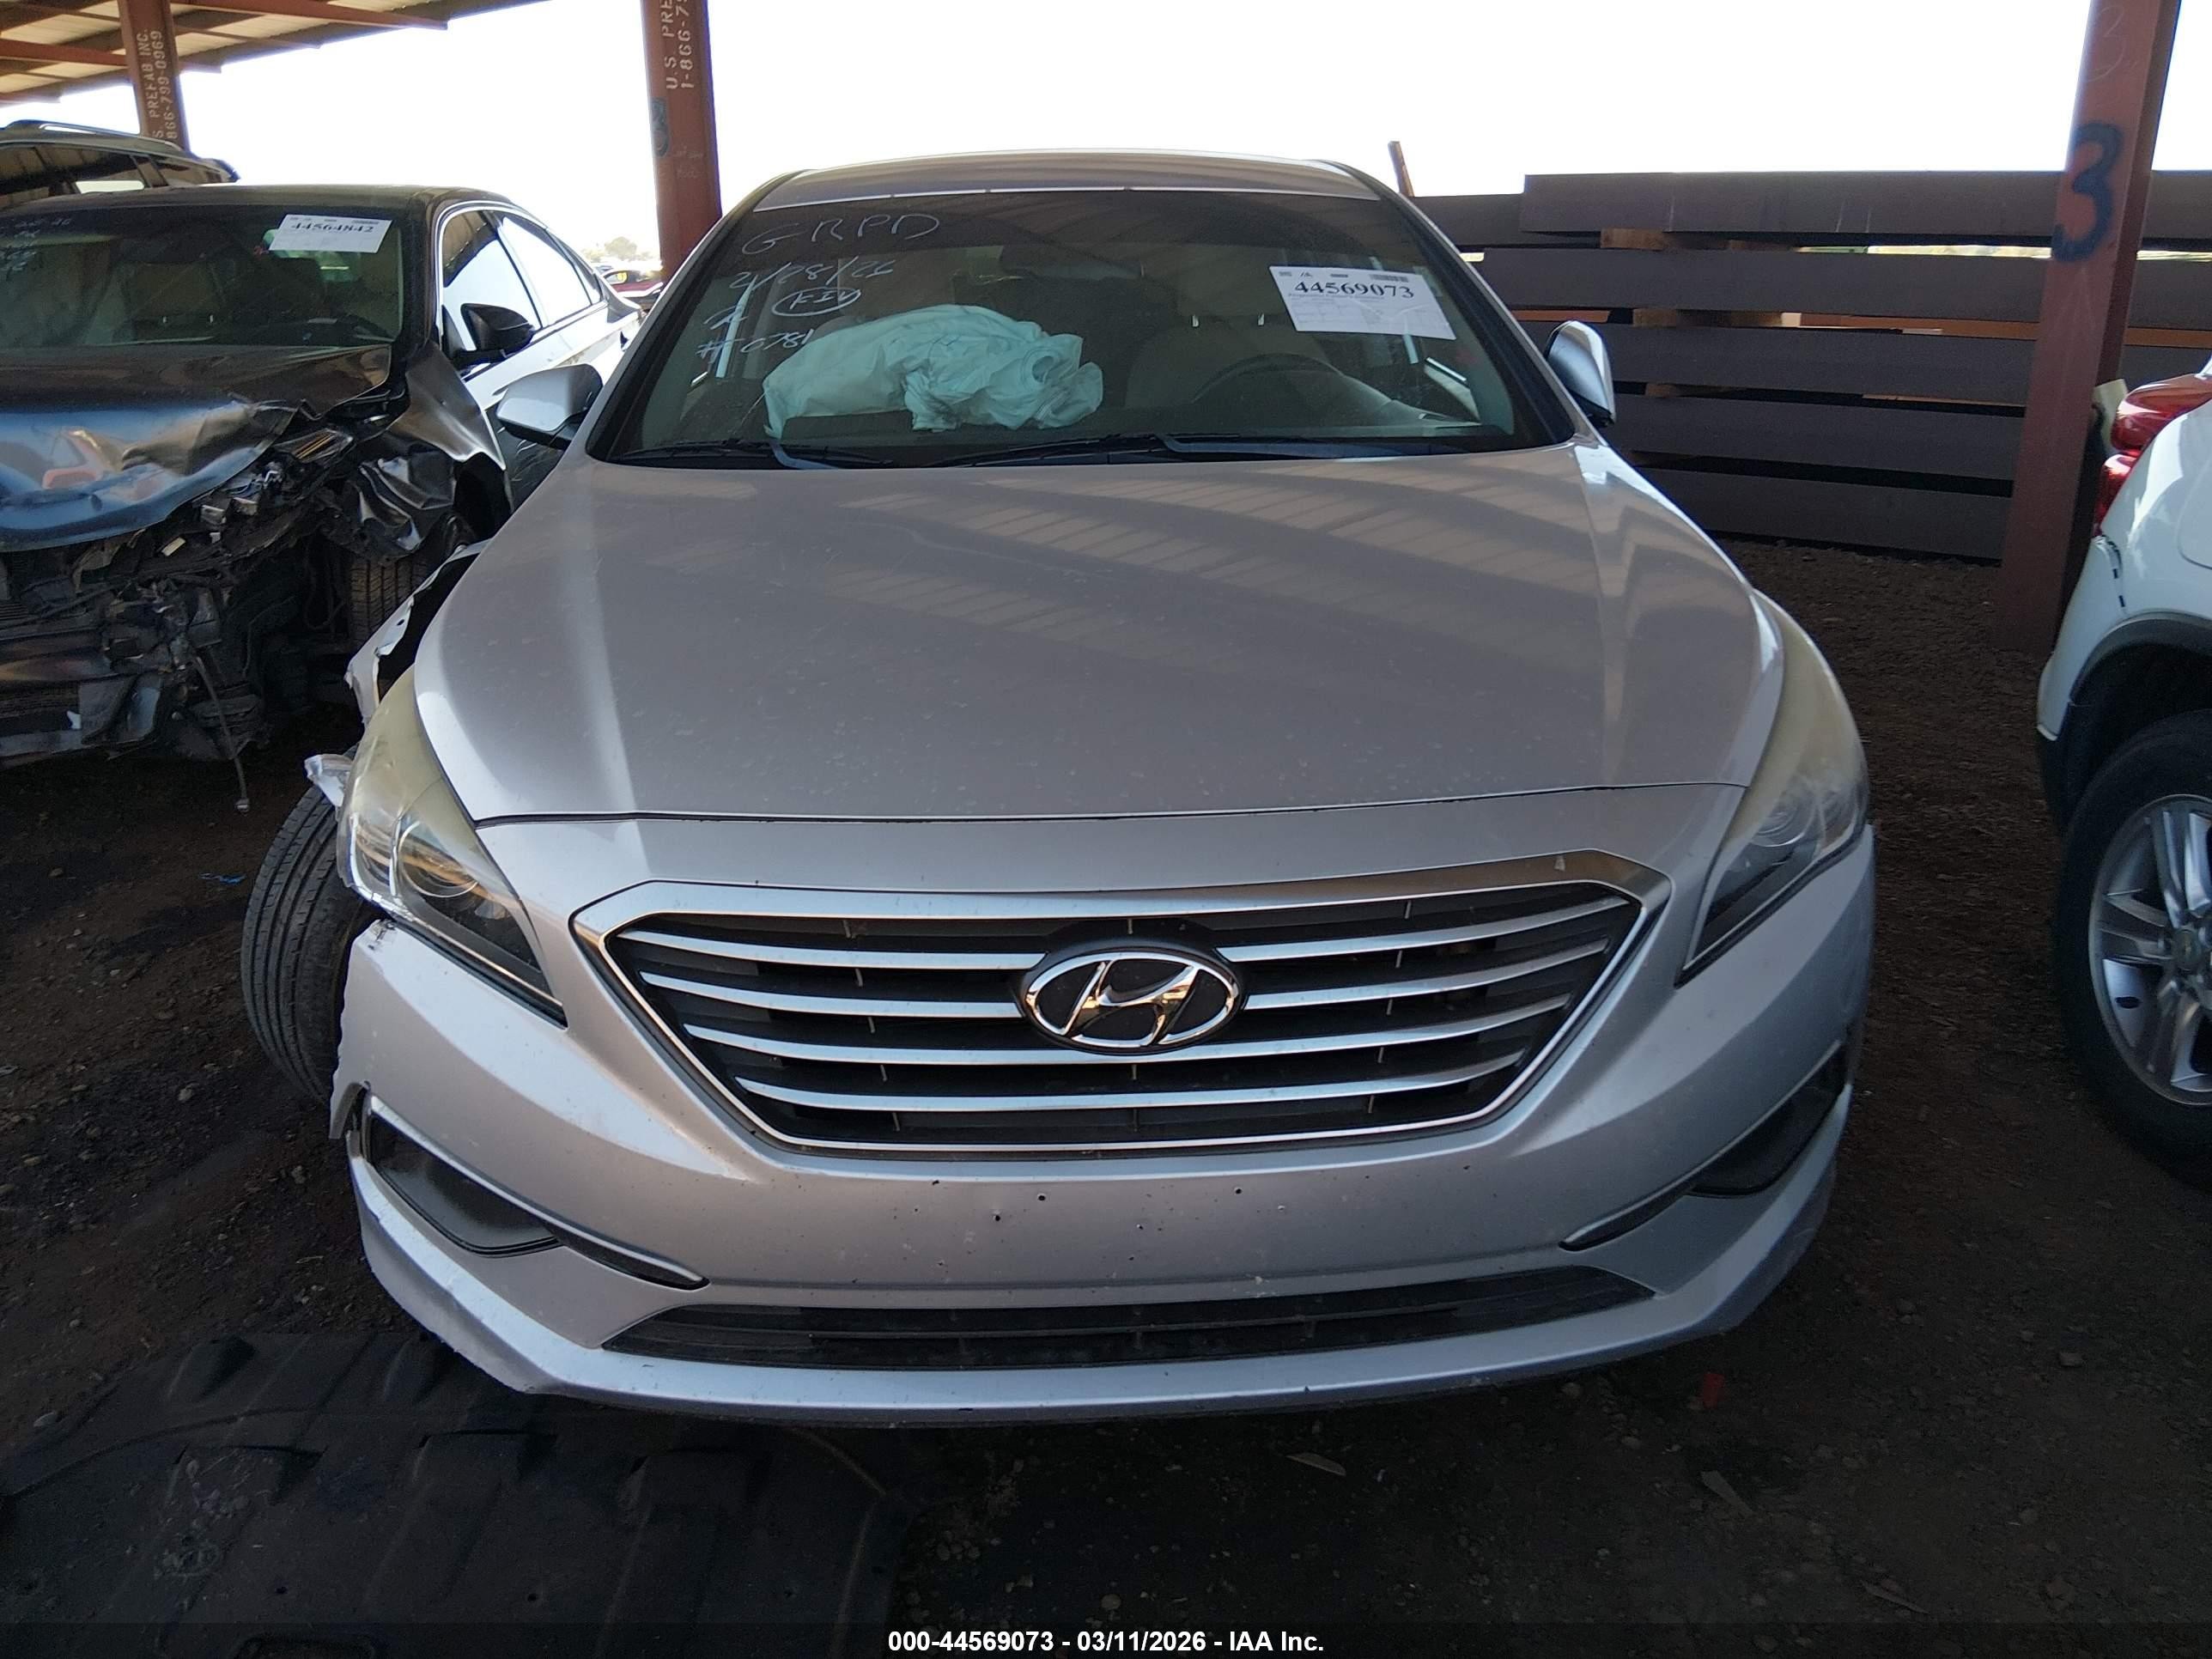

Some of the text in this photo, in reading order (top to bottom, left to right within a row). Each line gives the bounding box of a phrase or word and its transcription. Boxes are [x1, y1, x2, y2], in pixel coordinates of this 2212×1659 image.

[136, 28, 153, 57] INC.
[676, 0, 694, 88] 1-866-7
[141, 63, 161, 118] PREFAB
[2051, 122, 2123, 263] 3
[1294, 281, 1415, 299] 44569073
